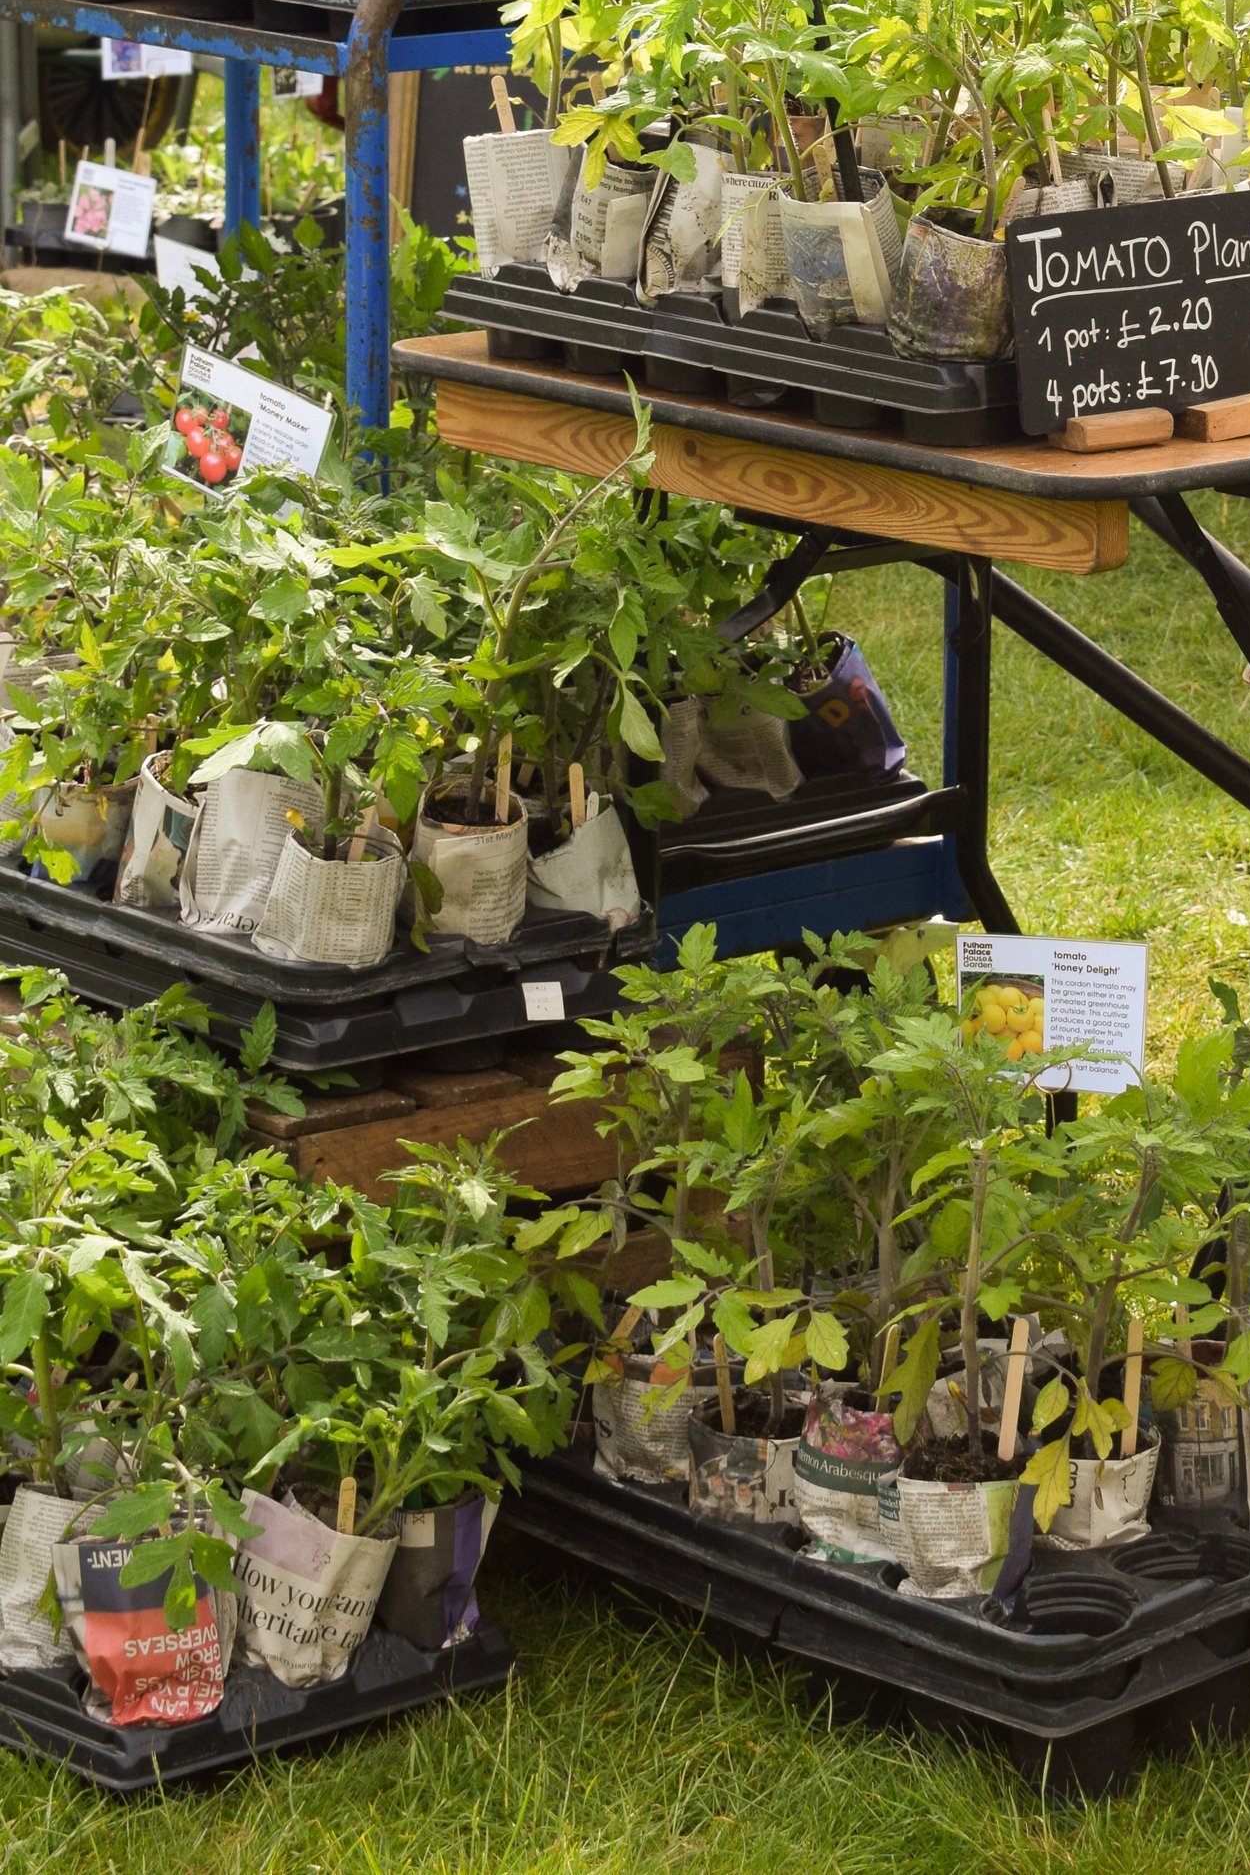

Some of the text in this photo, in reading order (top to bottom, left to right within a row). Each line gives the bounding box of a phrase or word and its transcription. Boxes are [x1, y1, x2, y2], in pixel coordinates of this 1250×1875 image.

[1016, 227, 1171, 293] TOMATO
[1038, 326, 1052, 352] 1
[1064, 317, 1110, 366] pot:
[190, 360, 211, 373] Palace
[191, 354, 214, 368] Fulham
[1046, 379, 1063, 416] 4
[1072, 368, 1131, 418] pots:
[260, 393, 286, 410] tomato
[474, 833, 513, 845] 31st May
[963, 942, 992, 950] Fulham
[963, 948, 991, 956] Palace
[1054, 951, 1087, 961] tomato
[1051, 978, 1136, 992] This cordon tomato may
[1063, 990, 1086, 998] grown
[1087, 990, 1107, 999] either
[1108, 991, 1115, 999] in
[1051, 997, 1129, 1010] unheated greenhouse
[1089, 1009, 1101, 1017] This
[1051, 1016, 1084, 1026] produces
[1093, 1019, 1112, 1028] good
[1114, 1021, 1130, 1029] crop
[1084, 1027, 1106, 1037] yellow
[1107, 1029, 1123, 1037] fruits
[230, 1552, 286, 1596] How
[280, 1583, 331, 1616] you
[124, 1622, 217, 1657] OVERSEAS
[175, 1643, 220, 1670] GROW
